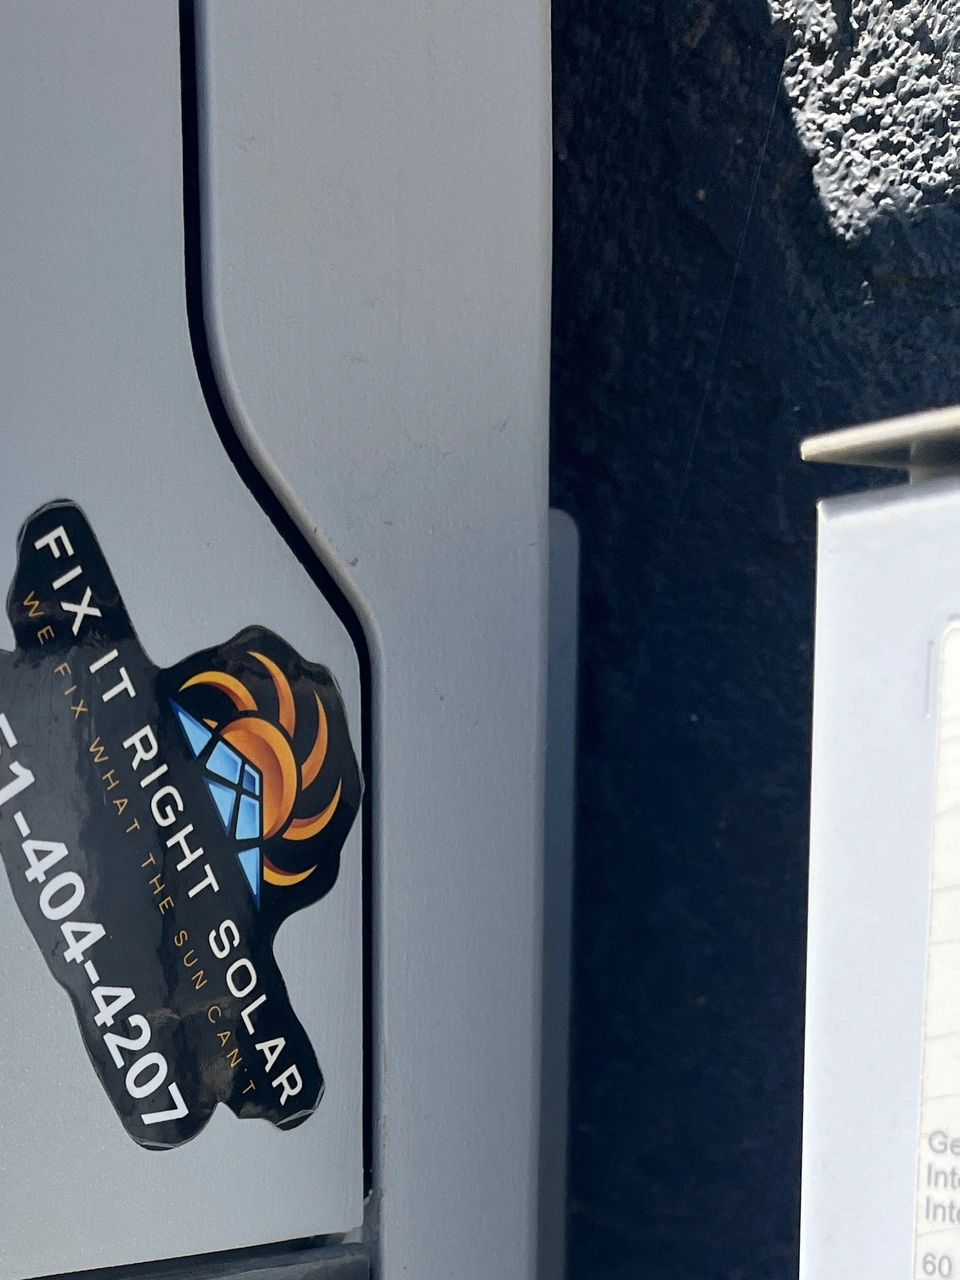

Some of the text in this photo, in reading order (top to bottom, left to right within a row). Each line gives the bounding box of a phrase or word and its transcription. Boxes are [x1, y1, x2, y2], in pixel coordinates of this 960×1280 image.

[23, 591, 256, 1094] WE FIX WHAT THE SUN CAN'T
[34, 525, 303, 1106] FIX IT RIGHT SOLAR
[922, 1252, 952, 1279] 60
[927, 1163, 960, 1189] Int
